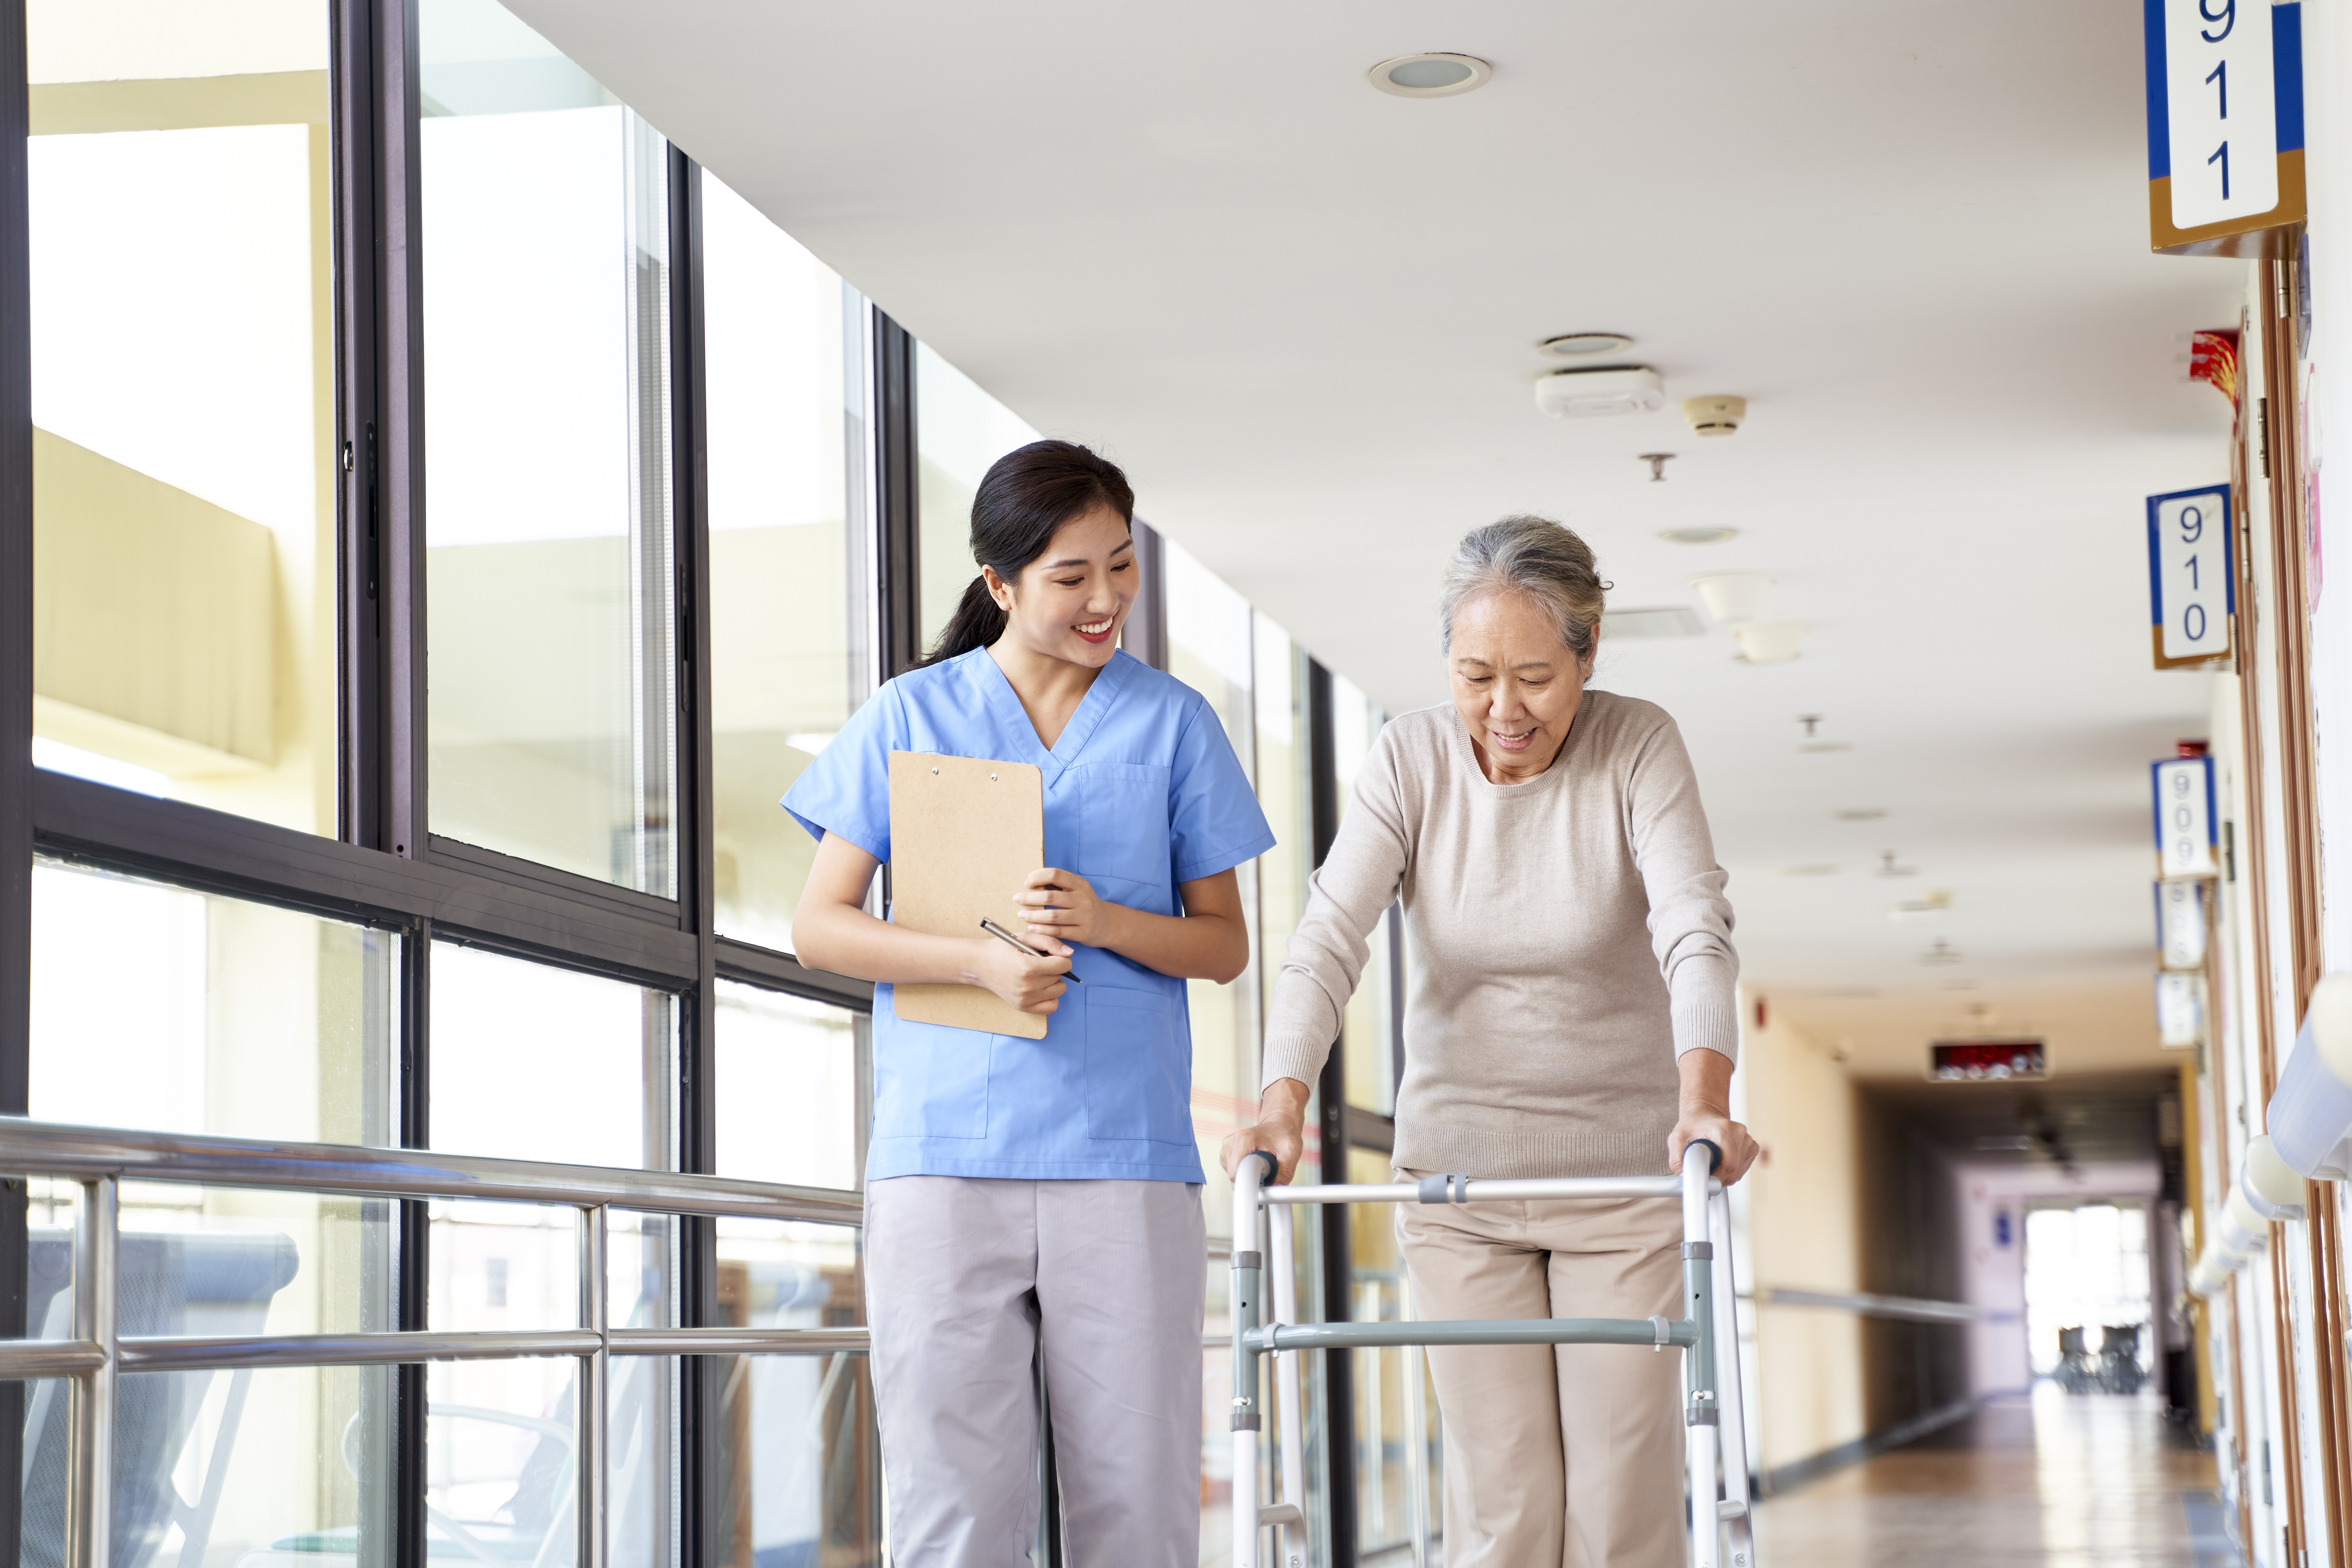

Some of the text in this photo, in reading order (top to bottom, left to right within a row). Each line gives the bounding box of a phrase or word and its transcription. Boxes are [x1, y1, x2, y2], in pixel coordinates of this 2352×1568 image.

[2199, 0, 2235, 201] 911
[2180, 506, 2206, 641] 910
[2173, 769, 2194, 867] 909
